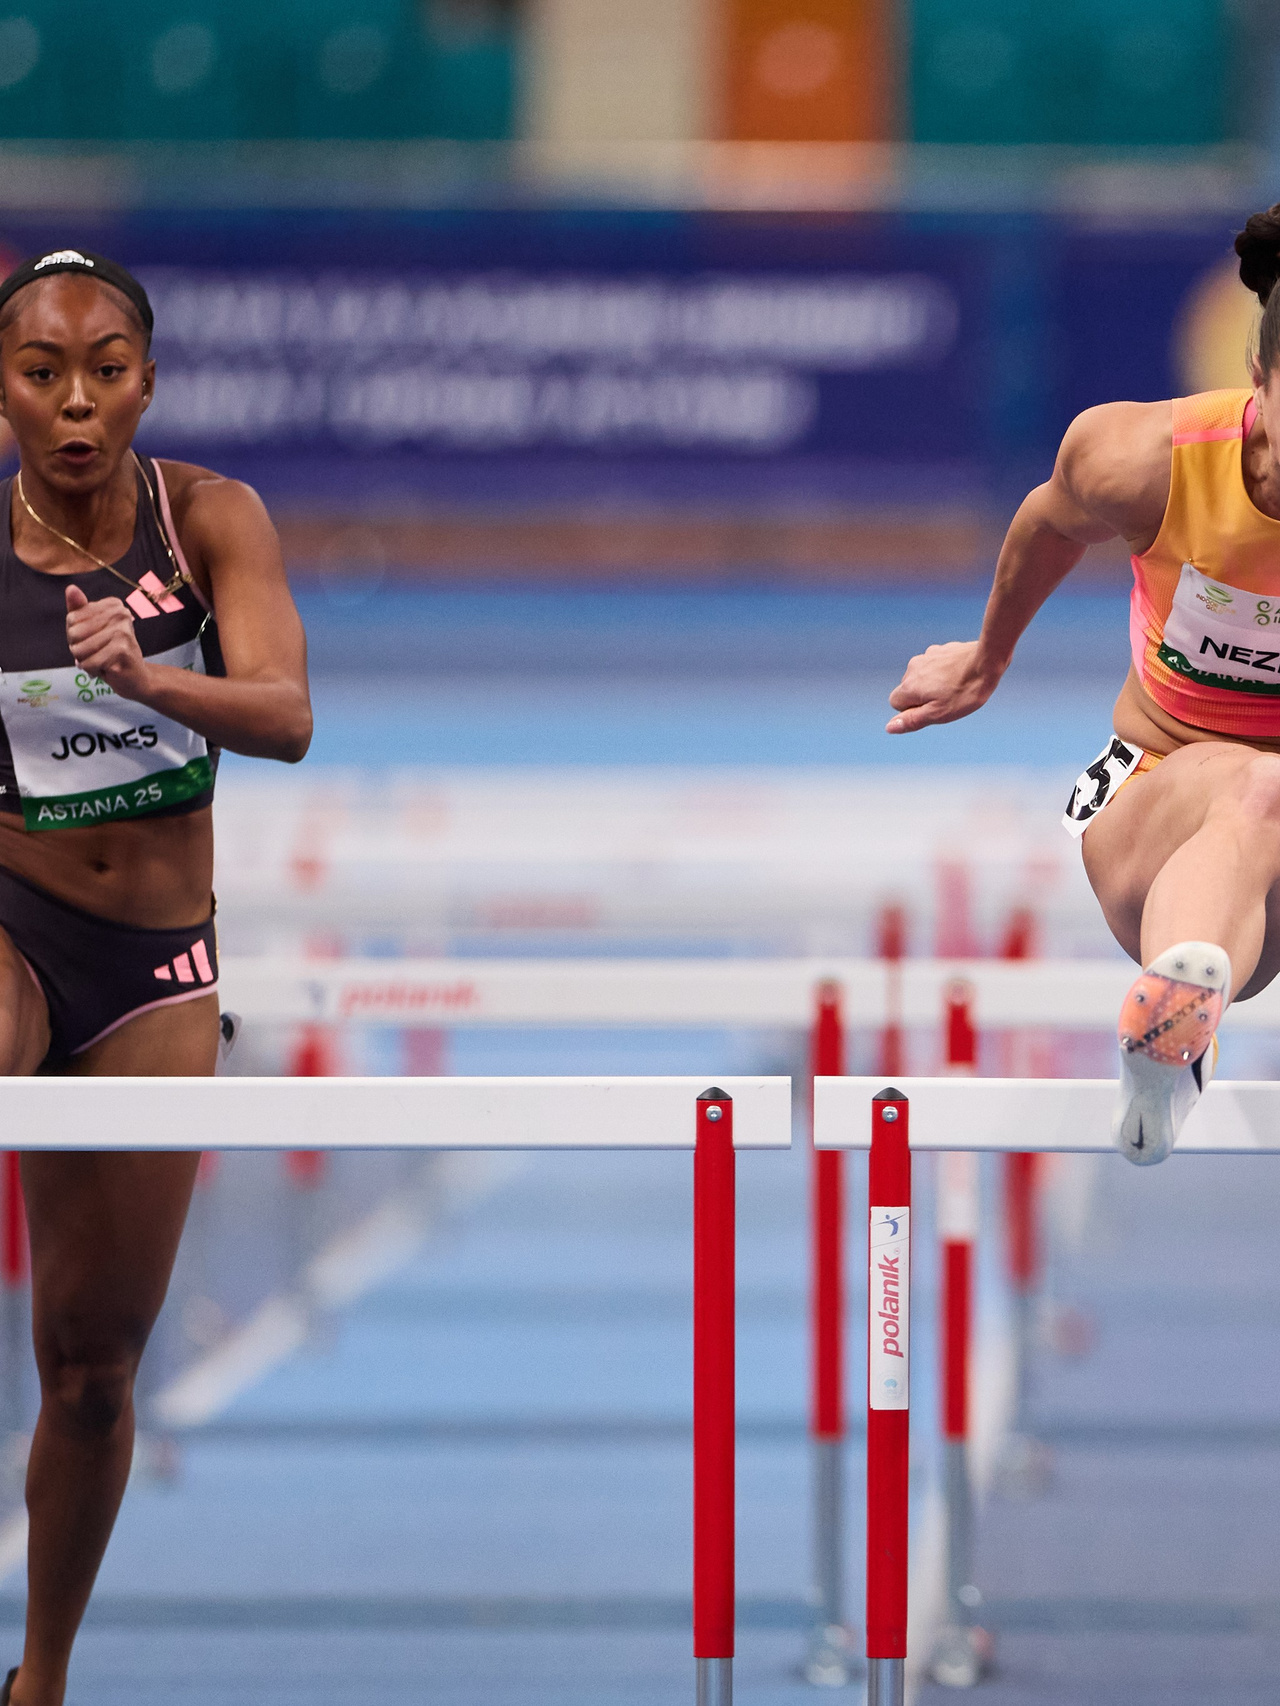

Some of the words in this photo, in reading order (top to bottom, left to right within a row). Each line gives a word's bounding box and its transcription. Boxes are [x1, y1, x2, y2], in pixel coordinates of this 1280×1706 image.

[52, 725, 158, 760] JONES
[38, 794, 129, 822] ASTANA
[134, 783, 162, 807] 25
[877, 1254, 905, 1358] polanik
